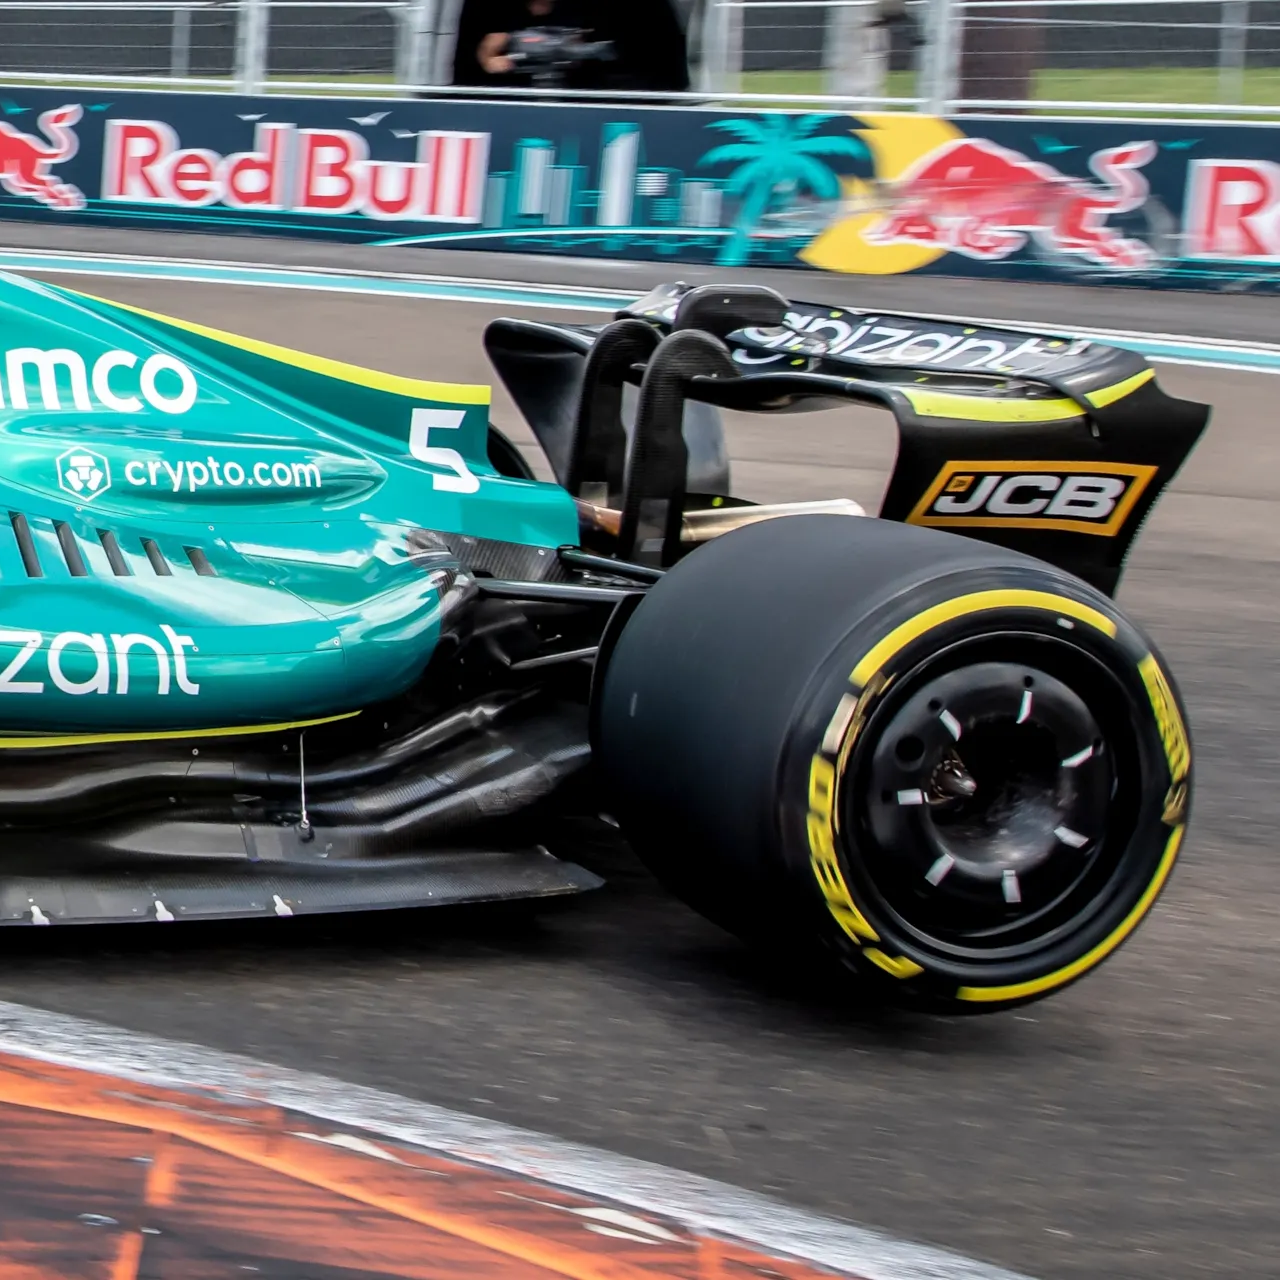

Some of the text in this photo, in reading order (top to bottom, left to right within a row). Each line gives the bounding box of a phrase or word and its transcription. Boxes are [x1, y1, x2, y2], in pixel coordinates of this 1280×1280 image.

[124, 453, 323, 493] crypto.com
[409, 408, 481, 493] 5
[933, 474, 1126, 519] JCB
